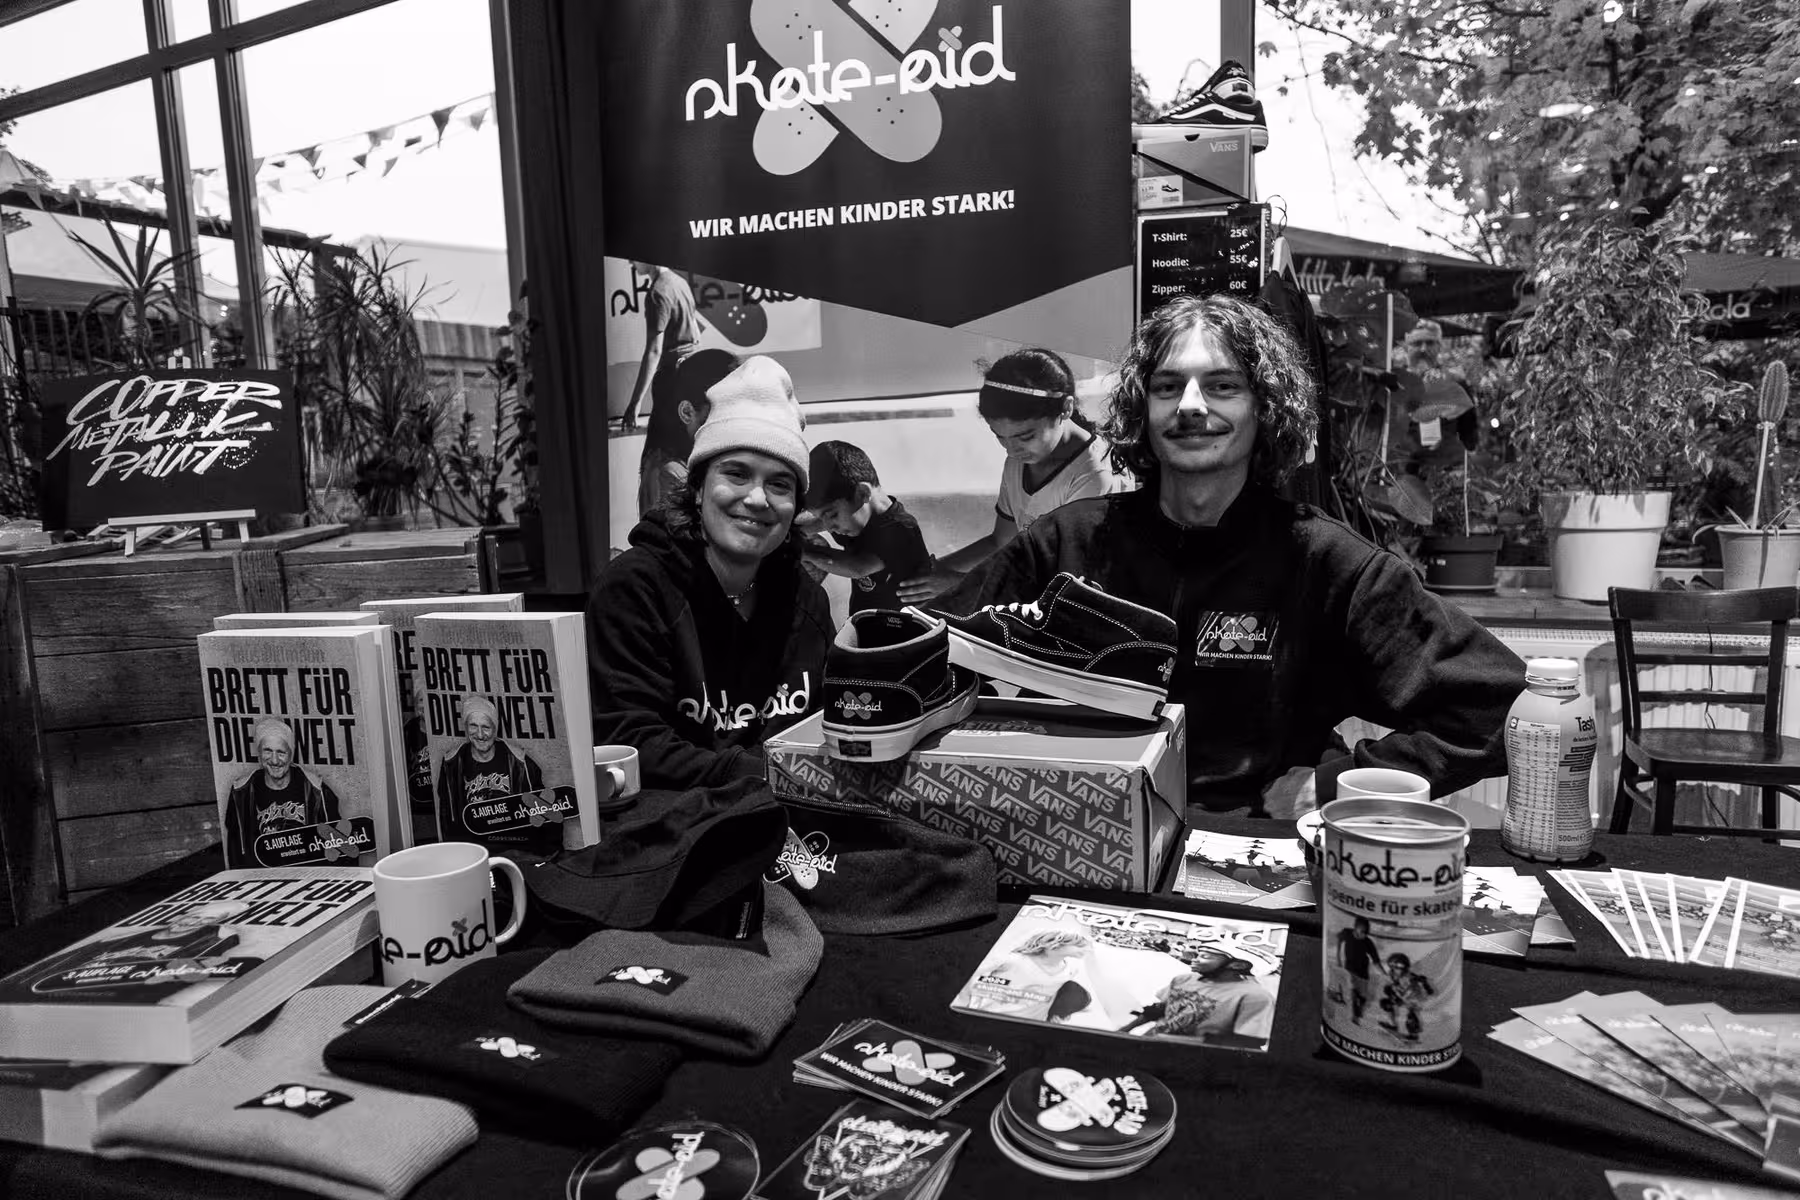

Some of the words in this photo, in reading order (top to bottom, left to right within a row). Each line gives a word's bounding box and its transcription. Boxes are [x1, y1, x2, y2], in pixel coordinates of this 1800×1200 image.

[686, 5, 1016, 121] skate-aid
[1209, 140, 1239, 152] VANS
[689, 218, 734, 239] WIR
[739, 207, 834, 235] MACHEN
[840, 198, 927, 225] KINDER
[931, 189, 1015, 216] STARK!
[1152, 233, 1188, 242] T-Shirt:
[1230, 228, 1248, 238] 25€
[1152, 258, 1189, 268] Hoodie:
[1229, 254, 1248, 264] 55€
[1151, 284, 1186, 295] Zipper:
[1229, 280, 1248, 290] 60€
[66, 375, 282, 425] COPPER
[87, 438, 250, 487] PAINT
[422, 647, 491, 692] BRETT
[501, 648, 553, 693] FÜR
[207, 667, 288, 714] BRETT
[297, 667, 354, 715] FÜR
[427, 693, 466, 737] DIE
[488, 696, 556, 739] WELT
[213, 717, 259, 763] DIE
[284, 718, 355, 766] WELT
[789, 753, 834, 792] VANS
[904, 765, 951, 806] VANS
[938, 762, 989, 799] VANS
[1067, 771, 1119, 812] VANS
[471, 802, 509, 819] 3.AUFLAGE
[514, 795, 573, 820] skate-aid
[954, 794, 1005, 833] VANS
[991, 786, 1042, 827] VANS
[1029, 779, 1080, 820] VANS
[264, 833, 303, 851] 3.AUFLAGE
[309, 826, 370, 852] skate-aid
[1009, 822, 1061, 862] VANS
[1046, 816, 1099, 855] VANS
[1064, 850, 1118, 889] VANS
[163, 879, 304, 901] BRETT
[283, 879, 373, 903] FÜR
[1381, 901, 1408, 916] für
[114, 902, 209, 927] DIE
[1342, 1041, 1394, 1064] MACHEN
[1397, 1054, 1442, 1066] KINDER
[837, 1060, 874, 1081] MACHEN
[873, 1075, 908, 1094] KINDER
